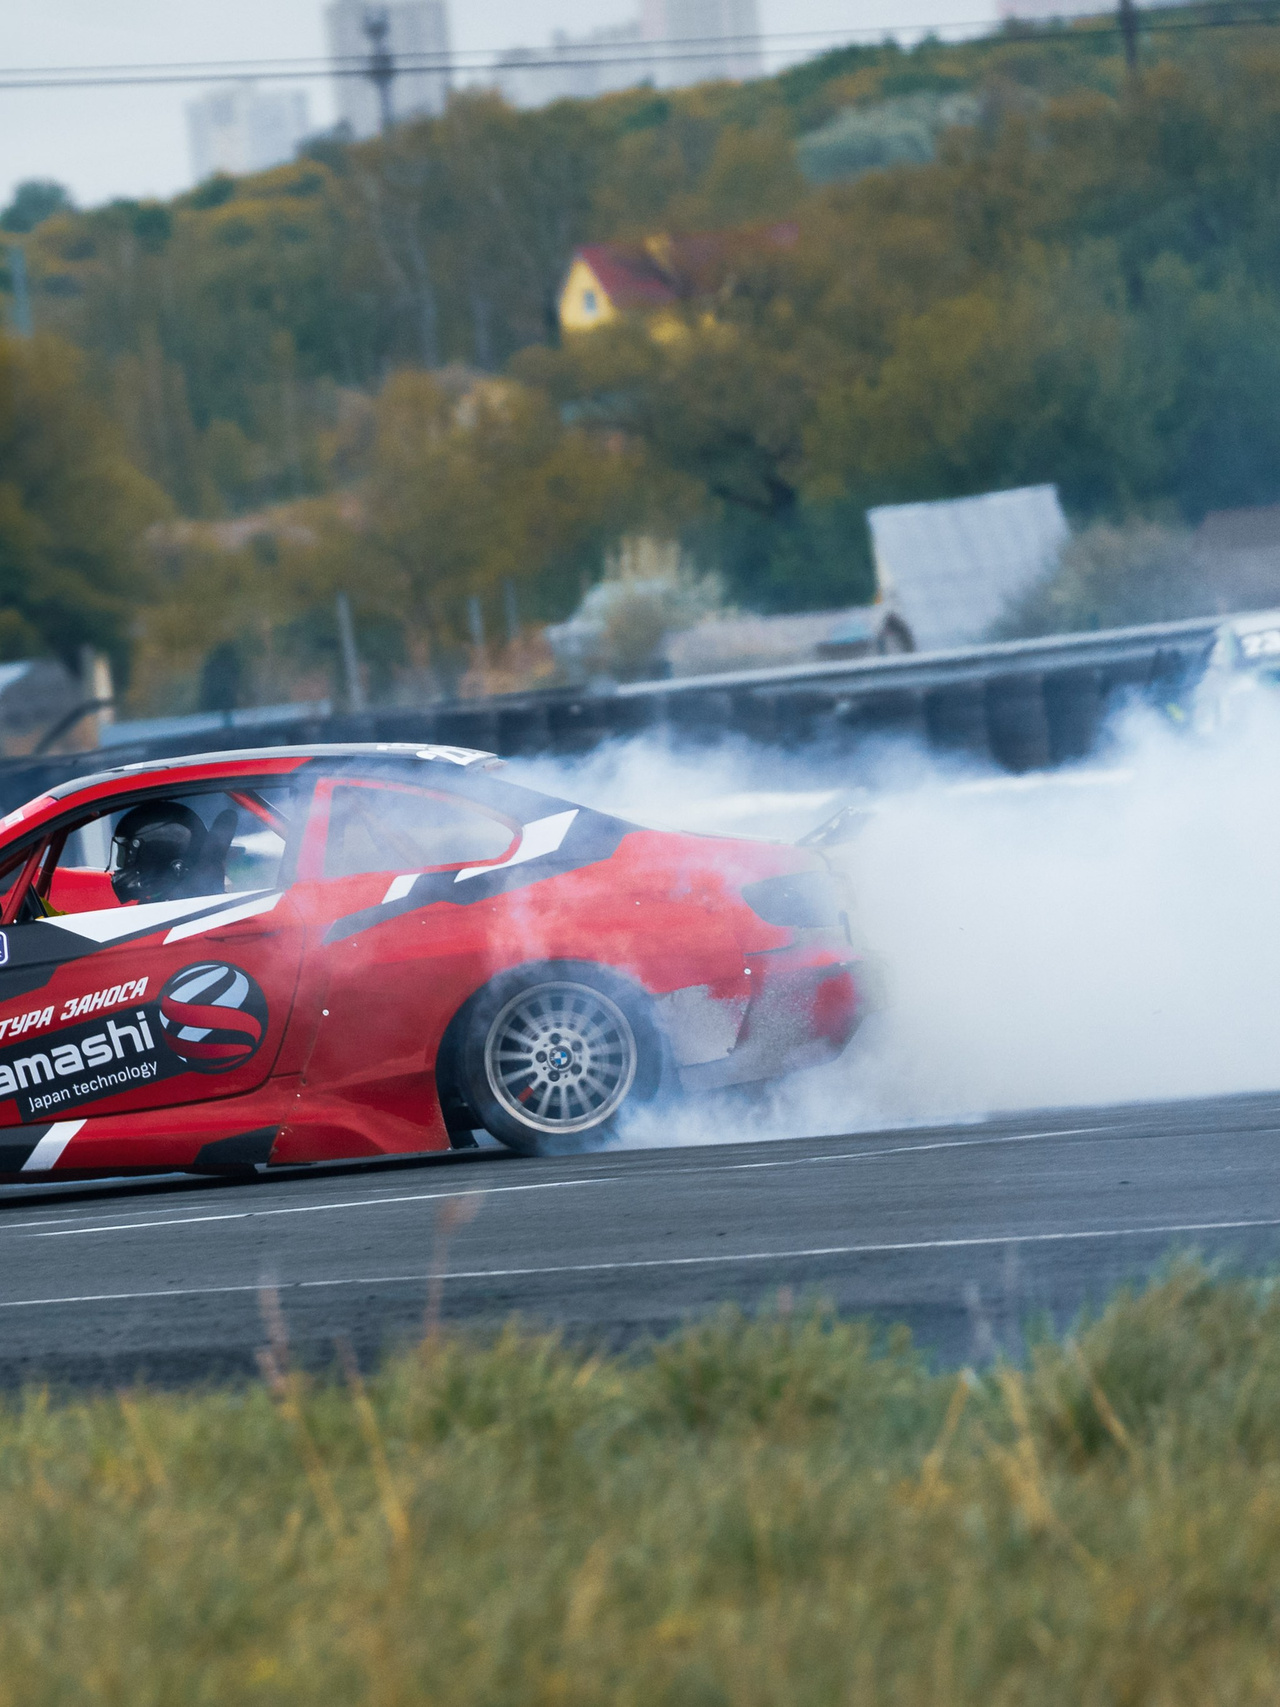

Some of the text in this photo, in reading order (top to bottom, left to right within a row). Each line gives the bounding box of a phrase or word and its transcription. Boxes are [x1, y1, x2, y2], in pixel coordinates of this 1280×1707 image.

[60, 976, 149, 1021] ЗАНОСА
[28, 1060, 157, 1112] Japan technology
